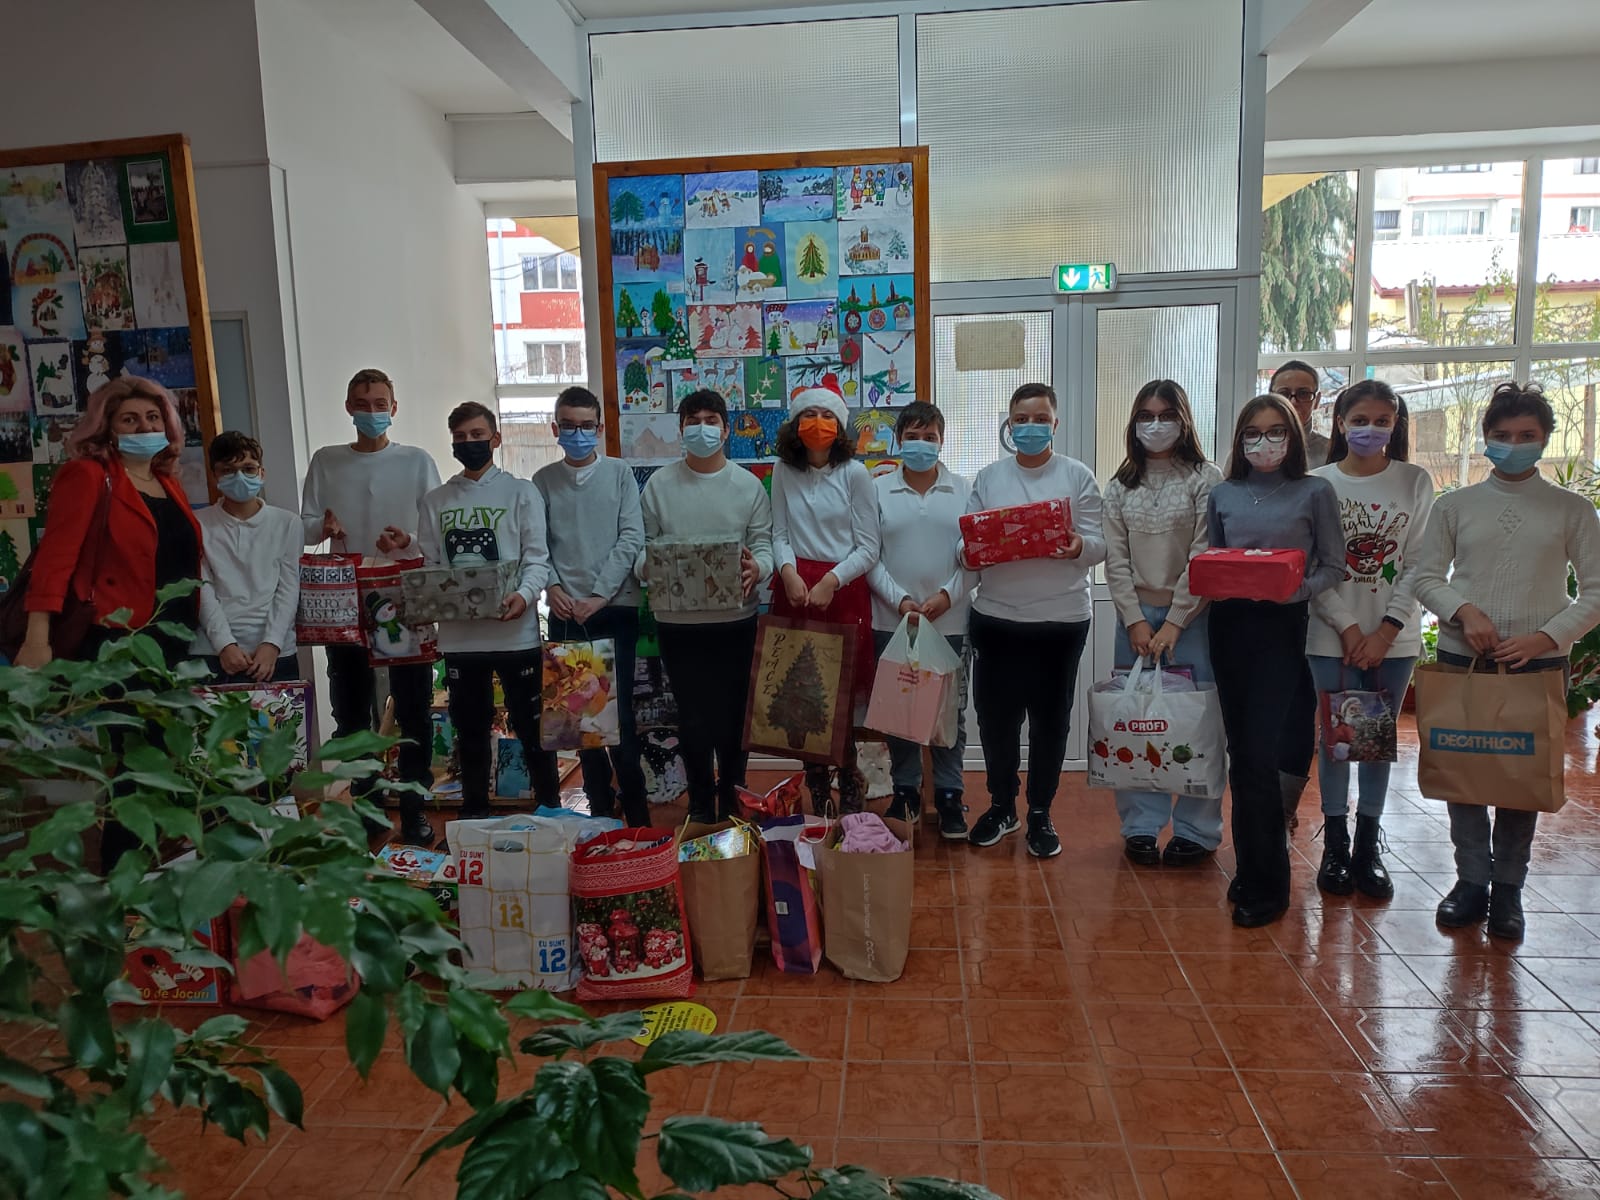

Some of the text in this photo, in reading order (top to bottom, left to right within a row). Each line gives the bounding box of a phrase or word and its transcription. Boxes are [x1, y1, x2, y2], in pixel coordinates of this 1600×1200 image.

[441, 508, 505, 532] PLAY
[1131, 721, 1165, 732] PROFI
[1437, 733, 1526, 750] DECATHLON
[458, 859, 484, 885] 12
[499, 903, 524, 928] 12
[539, 948, 567, 973] 12
